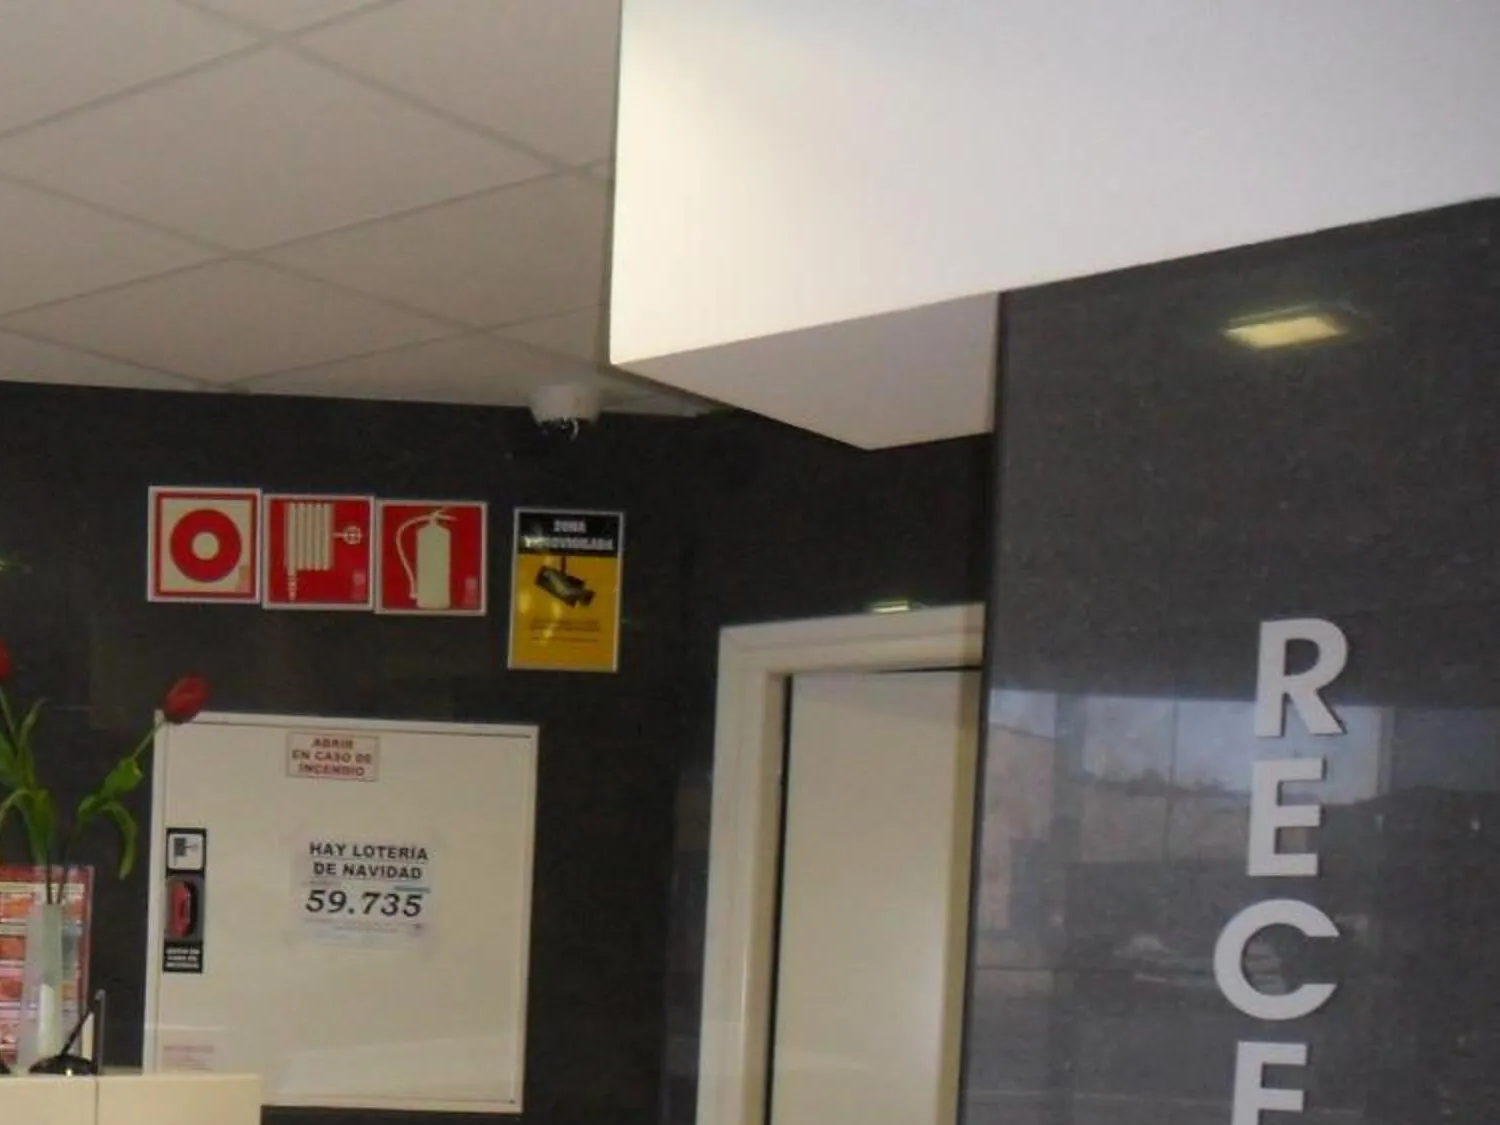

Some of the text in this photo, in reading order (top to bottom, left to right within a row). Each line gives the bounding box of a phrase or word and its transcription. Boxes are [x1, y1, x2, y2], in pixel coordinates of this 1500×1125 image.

[311, 738, 354, 749] ABRIR
[291, 750, 372, 764] EN CASO DE
[298, 763, 366, 777] INCENDIO
[309, 842, 346, 857] HAY
[313, 861, 423, 880] DE NAVIDAD
[304, 889, 425, 918] 59.735
